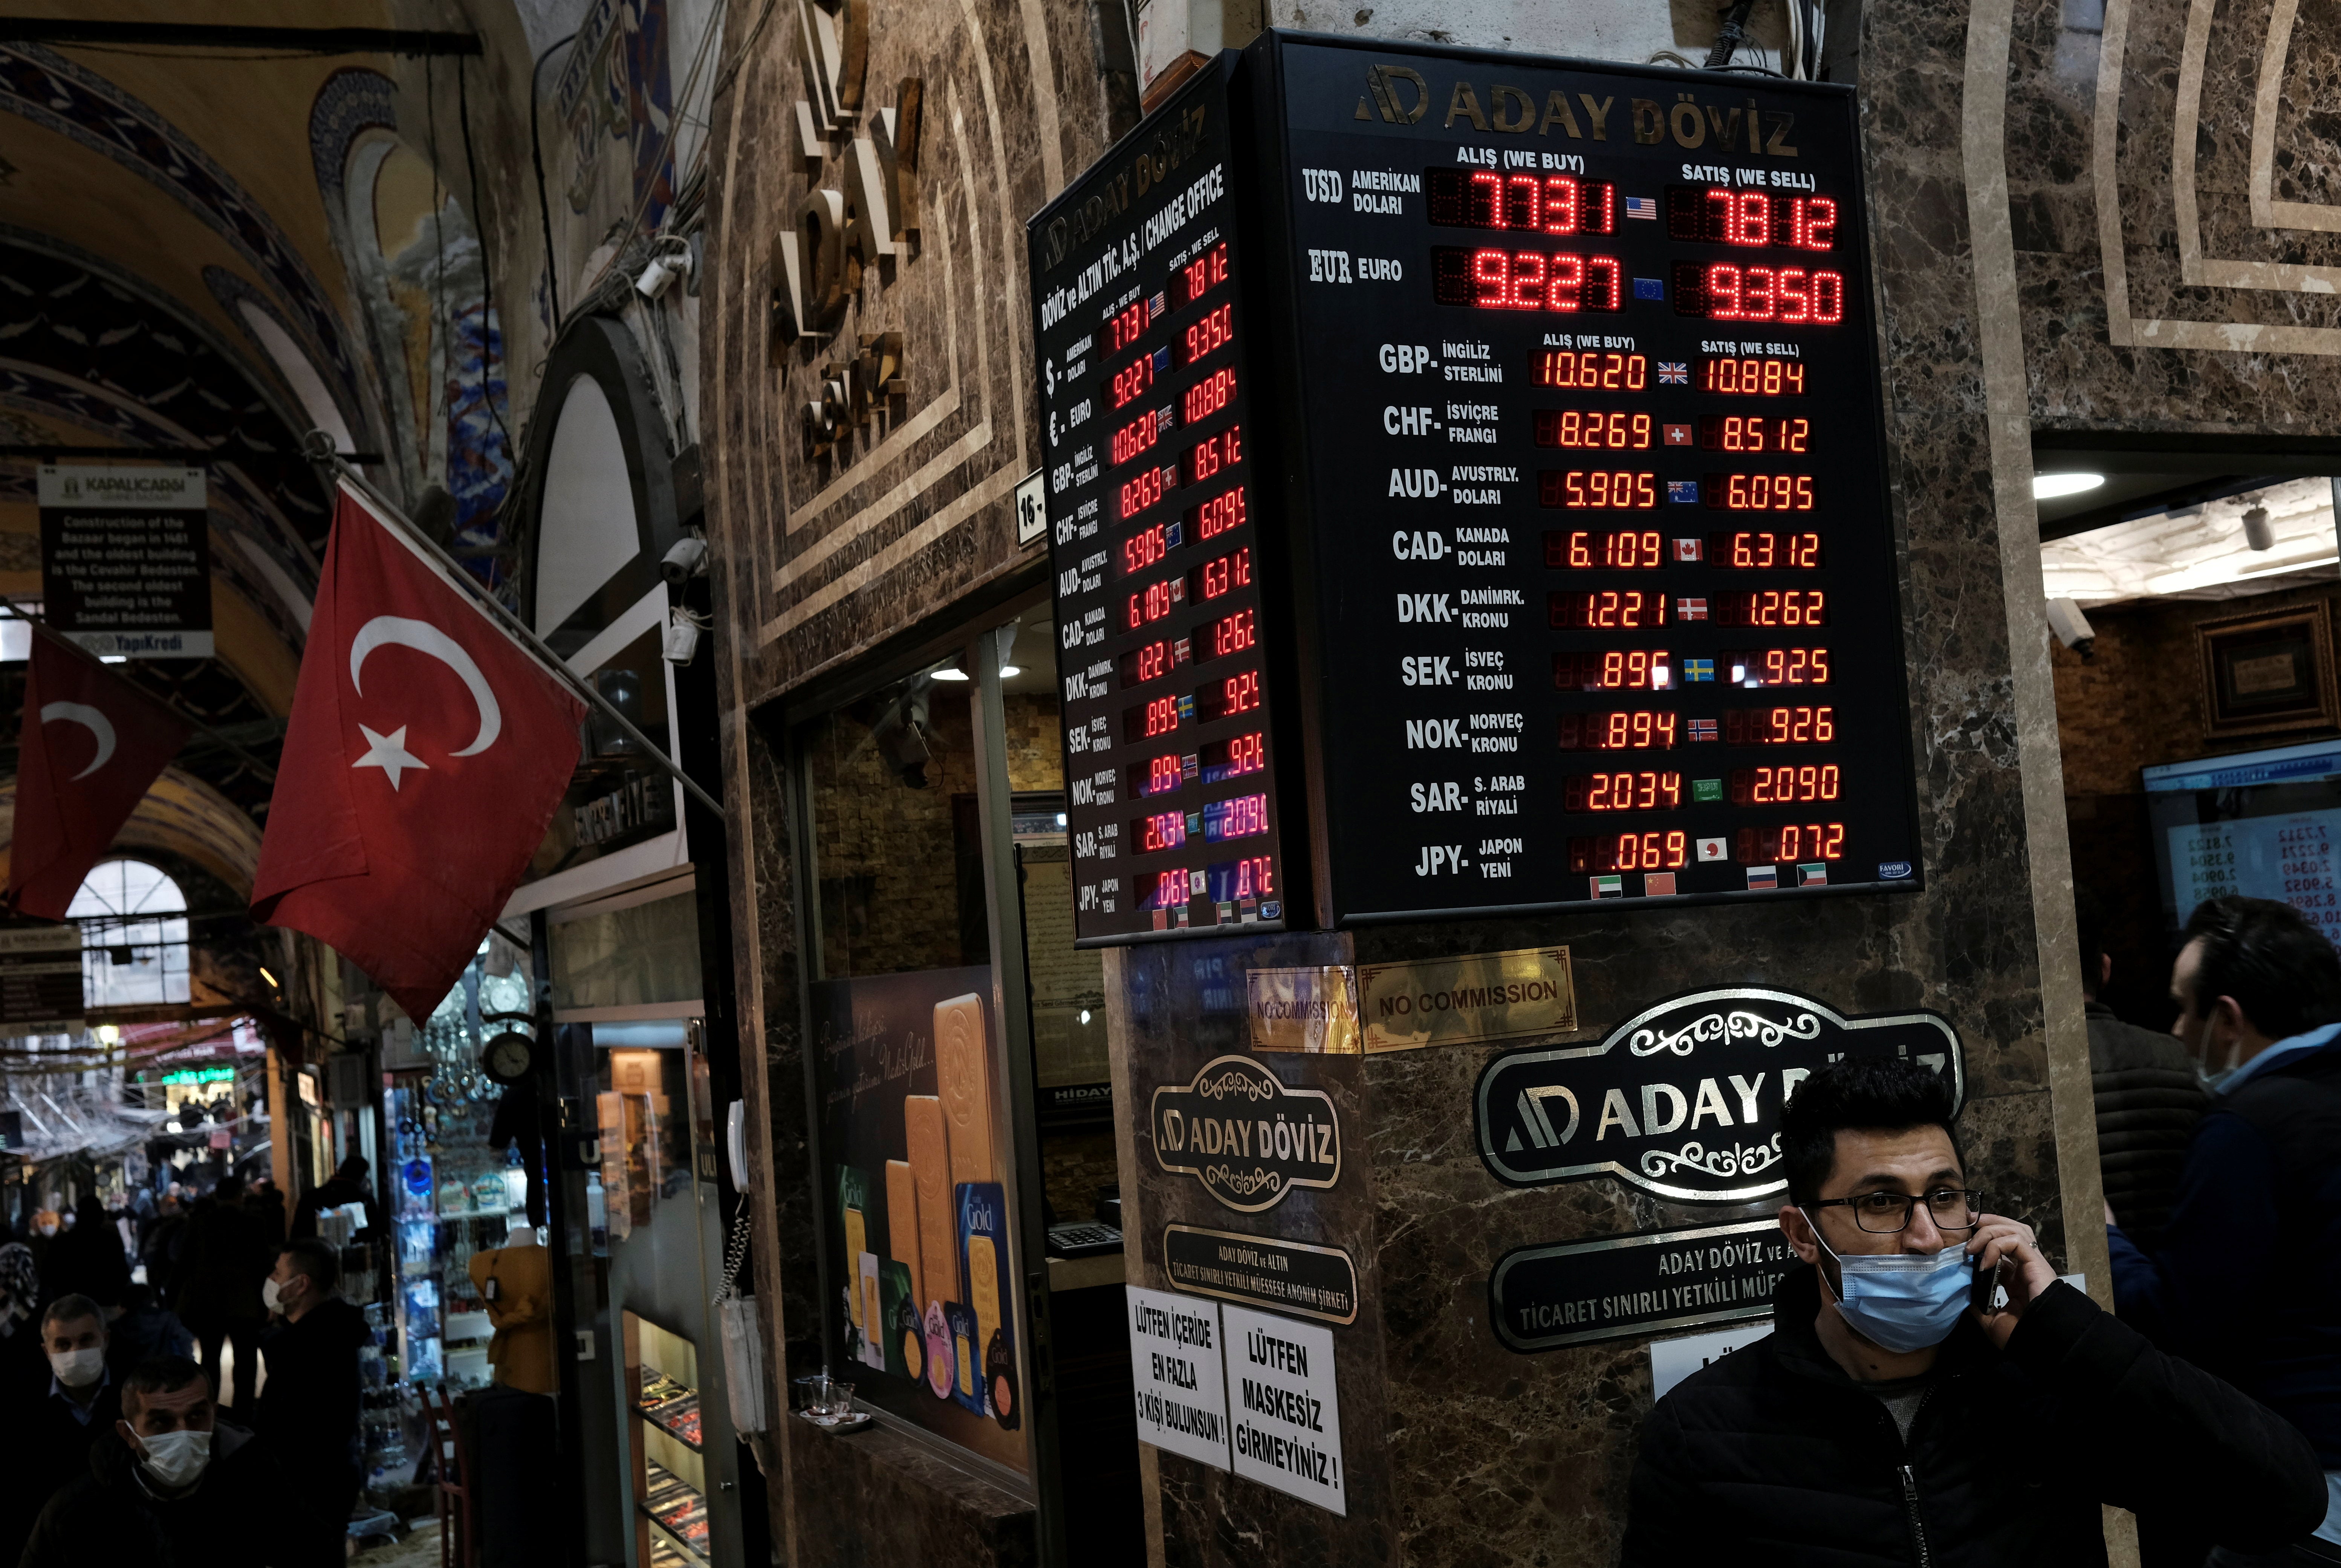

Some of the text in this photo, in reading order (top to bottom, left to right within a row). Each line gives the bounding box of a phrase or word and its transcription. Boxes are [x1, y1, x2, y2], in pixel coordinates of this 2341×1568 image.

[1444, 81, 1798, 157] ADAY DÖVİZ
[1457, 147, 1584, 174] ALIŞ (WE BUY)
[1303, 168, 1342, 203] USD
[1352, 168, 1420, 193] AMERİKAN
[1682, 164, 1815, 192] SATIŞ (WE SELL)
[1353, 194, 1402, 214] DOLARI
[1472, 173, 1613, 235] 7.731
[1707, 190, 1836, 251] 7.812
[1042, 163, 1223, 331] DÖVİZ ve ALTIN TİC. A.Ş. CHANGE OFFICE
[1309, 249, 1402, 283] EUR EURO
[1471, 249, 1619, 312] 9.227
[1709, 264, 1842, 324] 9.350
[1067, 334, 1092, 362] AMERİKAN
[1443, 340, 1490, 359] İNGİLİZ
[1544, 334, 1634, 351] ALIŞ (WE BUY)
[1702, 341, 1799, 358] SATIŞ (WE SELL)
[1068, 359, 1086, 382] DOLARI
[1380, 344, 1437, 373] GBP-
[1445, 364, 1502, 382] STERLİNİ
[1545, 353, 1645, 389] 10.620
[1709, 359, 1803, 394] 10.884
[1070, 399, 1091, 428] EURO
[1384, 406, 1441, 435] CHF-
[1447, 400, 1498, 424] İSVİÇRE
[1115, 411, 1156, 463] 10.620
[1449, 428, 1496, 443] FRANGI
[1561, 412, 1650, 448] 8.269
[1724, 417, 1807, 452] 8.512
[1053, 463, 1073, 493] GBP-
[1389, 469, 1447, 497] AUD-
[1452, 466, 1518, 481] AVUSTRLY.
[1454, 489, 1500, 504] DOLARI
[1567, 472, 1653, 507] 5.905
[1729, 475, 1812, 509] 6.095
[64, 515, 184, 529] Construction of the
[1057, 515, 1076, 545] CHF-
[1456, 528, 1509, 543] KANADA
[61, 531, 104, 545] Bazaar
[107, 532, 146, 547] began
[1127, 524, 1164, 572] 5.905
[1393, 531, 1451, 559] CAD-
[1570, 533, 1659, 567] 6.109
[1734, 533, 1818, 567] 6.312
[1458, 551, 1505, 565] DOLARI
[72, 579, 183, 592] The second oldest
[1060, 568, 1081, 598] AUD-
[1461, 586, 1524, 604] DANİMRK.
[1085, 607, 1105, 625] KANADA
[1398, 594, 1458, 622] DKK-
[1463, 613, 1508, 627] KRONU
[1589, 593, 1664, 626] 1.221
[1752, 592, 1823, 625] 1.262
[1063, 620, 1084, 649] CAD-
[1402, 657, 1459, 686] SEK-
[1466, 648, 1503, 671] İSVEÇ
[1760, 650, 1827, 683] .925
[1066, 672, 1088, 701] DKK-
[1467, 675, 1513, 690] KRONU
[1407, 719, 1468, 748] NOK-
[1470, 713, 1523, 732] NORVEÇ
[1602, 713, 1674, 747] .894
[1765, 708, 1832, 742] .926
[1070, 726, 1090, 753] SEK-
[1472, 737, 1517, 752] KRONU
[1073, 778, 1095, 805] NOK-
[1411, 782, 1468, 812] SAR-
[1475, 776, 1524, 792] S. ARAB
[1589, 773, 1679, 809] 2.034
[1754, 766, 1838, 801] 2.090
[1476, 795, 1517, 815] RİYALİ
[1076, 832, 1097, 858] SAR-
[1479, 838, 1522, 855] JAPON
[1612, 831, 1684, 870] .069
[1775, 824, 1843, 861] .072
[1416, 845, 1468, 876] JPY-
[1480, 857, 1511, 878] YENİ
[1880, 862, 1904, 872] FAVORİ
[1080, 885, 1098, 911] JPY-
[1257, 1001, 1350, 1019] NO COMMISSION
[1380, 981, 1558, 1016] NO COMMISSION
[1596, 1072, 1765, 1141] ADAY
[1191, 1113, 1334, 1164] ADAY DÖVİZ
[967, 1204, 993, 1231] Gold
[1219, 1245, 1235, 1263] ADAY
[1237, 1246, 1258, 1267] DÖVİZ
[1268, 1254, 1288, 1272] ALTIN
[1658, 1249, 1705, 1276] ADAY
[1709, 1238, 1763, 1268] DÖVİZ
[1173, 1259, 1348, 1311] TİCARET SINIRLI YETKİLİ MÜESSESE ANONİM ŞİRKETİ
[1520, 1299, 1597, 1330] TİCARET
[1603, 1289, 1668, 1318] SINIRLI
[1672, 1275, 1736, 1308] YETKİLİ
[1135, 1300, 1211, 1349] LÜTFEN İÇERİDE
[1248, 1328, 1308, 1377] LÜTFEN
[1152, 1352, 1197, 1391] EN FAZLA
[1138, 1388, 1219, 1443] 3 KİŞİ BULUNSUN
[1242, 1378, 1323, 1433] MASKESİZ
[1236, 1419, 1328, 1486] GİRMEYİNİZ
